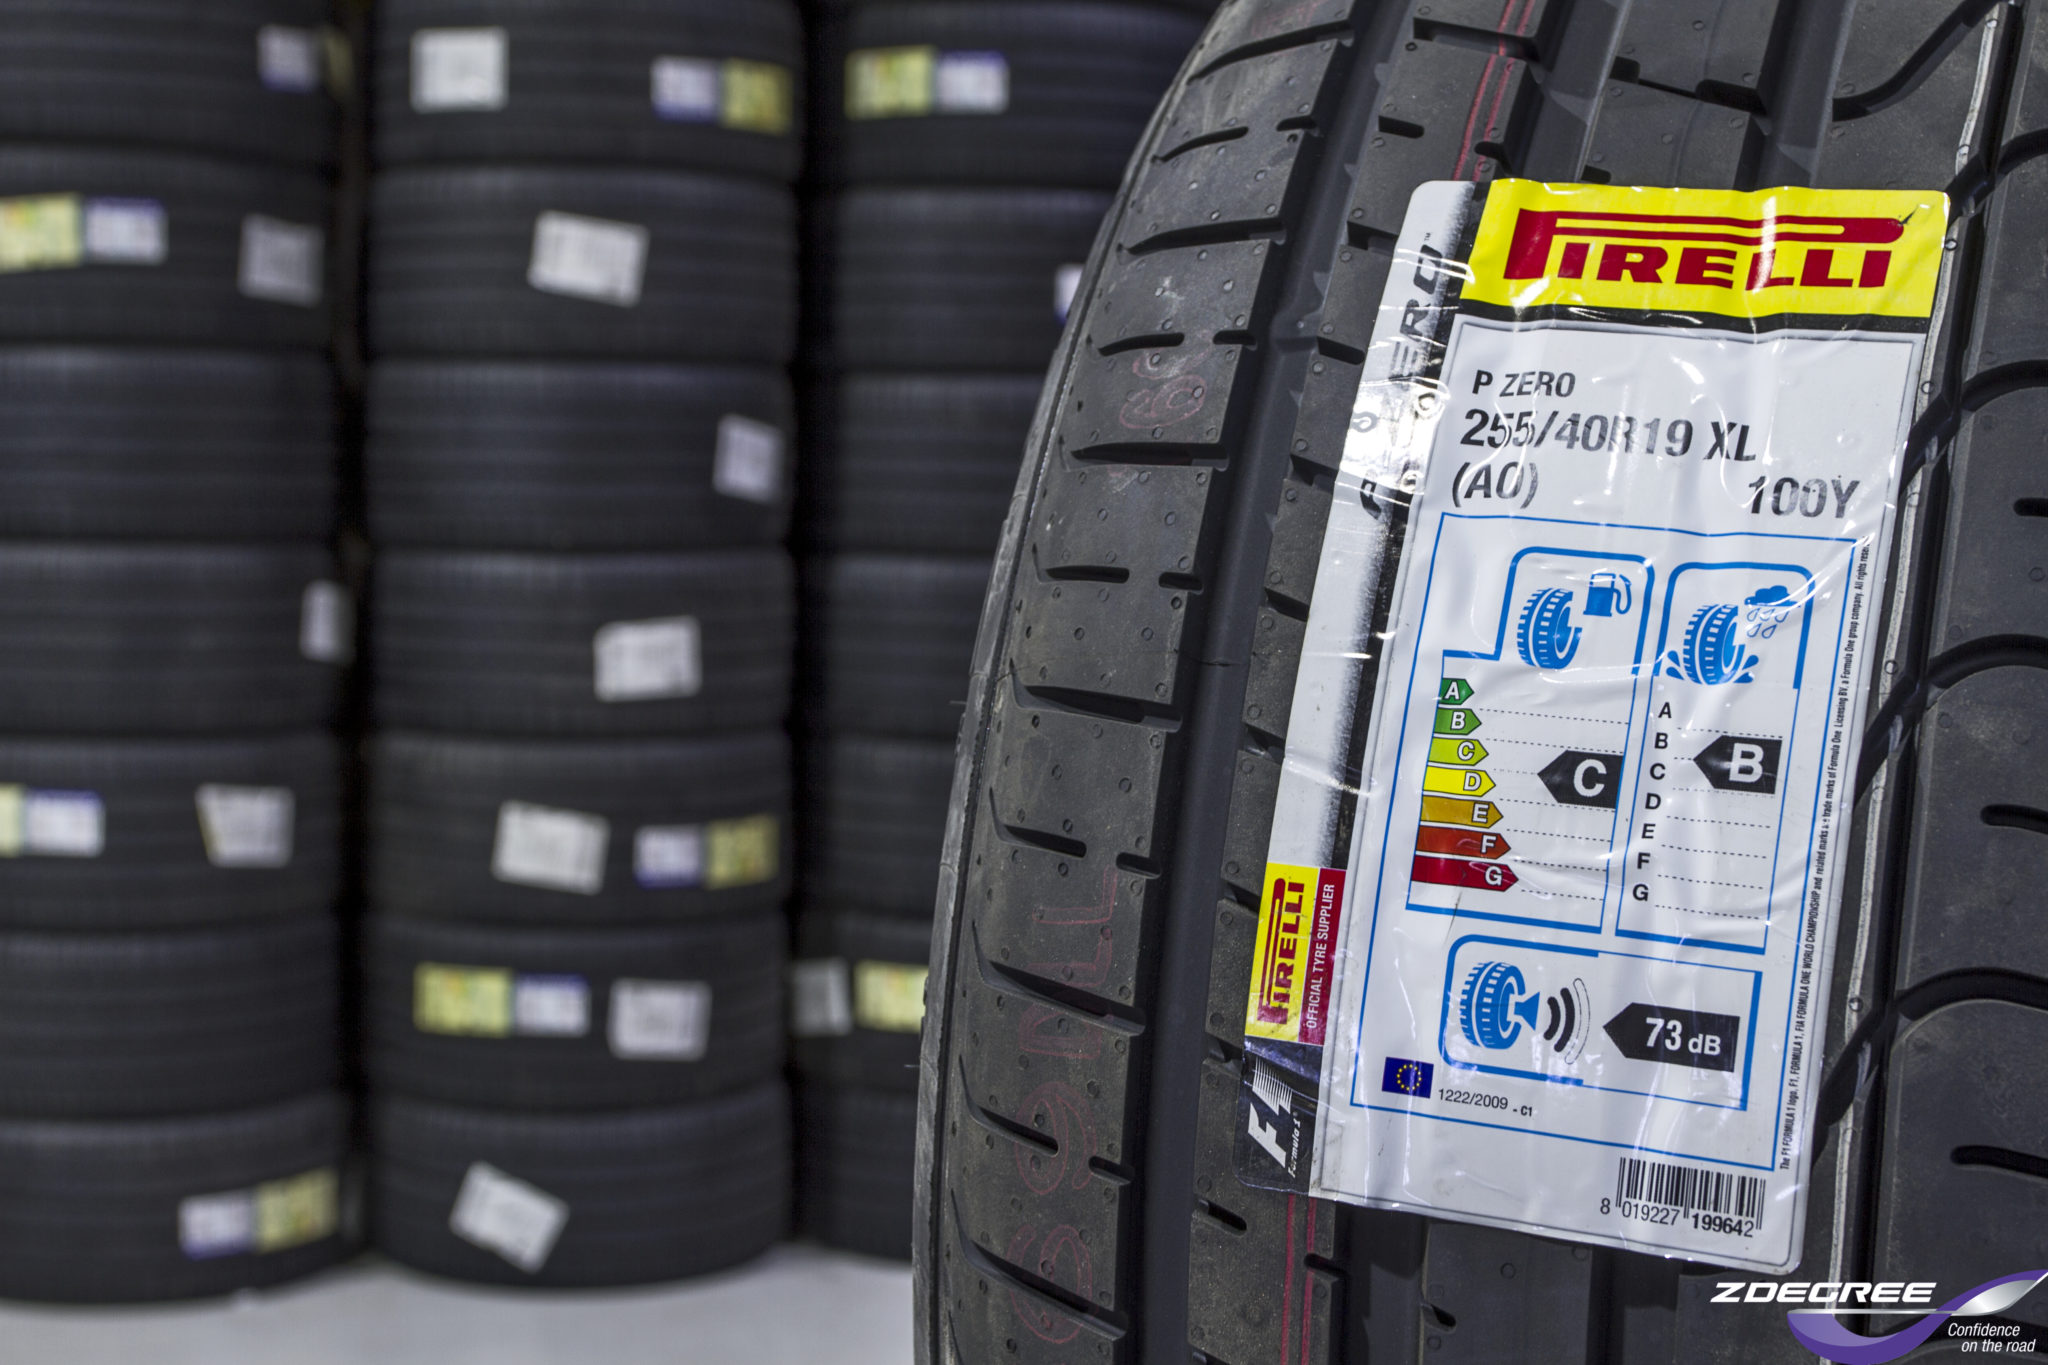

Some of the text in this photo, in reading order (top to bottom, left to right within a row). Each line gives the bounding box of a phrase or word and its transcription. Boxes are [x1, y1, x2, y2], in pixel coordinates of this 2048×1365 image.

[1503, 208, 1904, 291] PIRELLI
[1472, 369, 1576, 397] P ZERO
[1460, 408, 1757, 461] 255/40R19 XL
[1748, 475, 1860, 518] 100Y
[1854, 561, 1869, 581] rights
[1853, 580, 1864, 590] All
[1846, 620, 1860, 639] group
[1843, 638, 1855, 652] One
[1839, 652, 1853, 679] Formula
[1444, 680, 1460, 700] A
[1451, 711, 1466, 730] B
[1658, 702, 1672, 719] A
[1833, 696, 1848, 728] Licensing
[1654, 732, 1668, 749] B
[1831, 729, 1842, 743] One
[1457, 741, 1475, 761] C
[1827, 743, 1841, 771] Formula
[1650, 763, 1666, 780] C
[1729, 743, 1764, 783] B
[1463, 770, 1482, 791] D
[1573, 759, 1607, 797] C
[1826, 770, 1837, 779] of
[1823, 778, 1836, 799] marks
[1645, 793, 1661, 810] D
[1821, 799, 1833, 817] trade
[1472, 802, 1489, 823] E
[1641, 823, 1656, 839] E
[1816, 829, 1829, 850] marks
[1480, 834, 1497, 853] F
[1637, 852, 1651, 869] F
[1813, 850, 1827, 875] related
[1485, 865, 1503, 886] G
[1811, 876, 1823, 890] and
[1632, 884, 1649, 901] G
[1804, 890, 1822, 943] CHAMPIONSHIP
[1257, 878, 1305, 1025] PIRELLI
[1306, 884, 1335, 1029] OFFICIAL TYRE SUPPLIER
[1801, 943, 1815, 969] WORLD
[1799, 969, 1811, 984] ONE
[1795, 984, 1810, 1019] FORMULA
[1794, 1019, 1806, 1032] FIA
[1645, 1017, 1721, 1056] 73 dB
[1789, 1039, 1804, 1075] FORMULA
[1788, 1074, 1800, 1087] F1,
[1438, 1088, 1508, 1110] 1222/2009
[1520, 1105, 1533, 1117] C1
[1781, 1112, 1796, 1146] FORMULA
[1288, 1128, 1300, 1178] Formula
[1780, 1145, 1792, 1156] F1
[1778, 1156, 1791, 1170] The
[1600, 1197, 1754, 1238] 8 019227 199642
